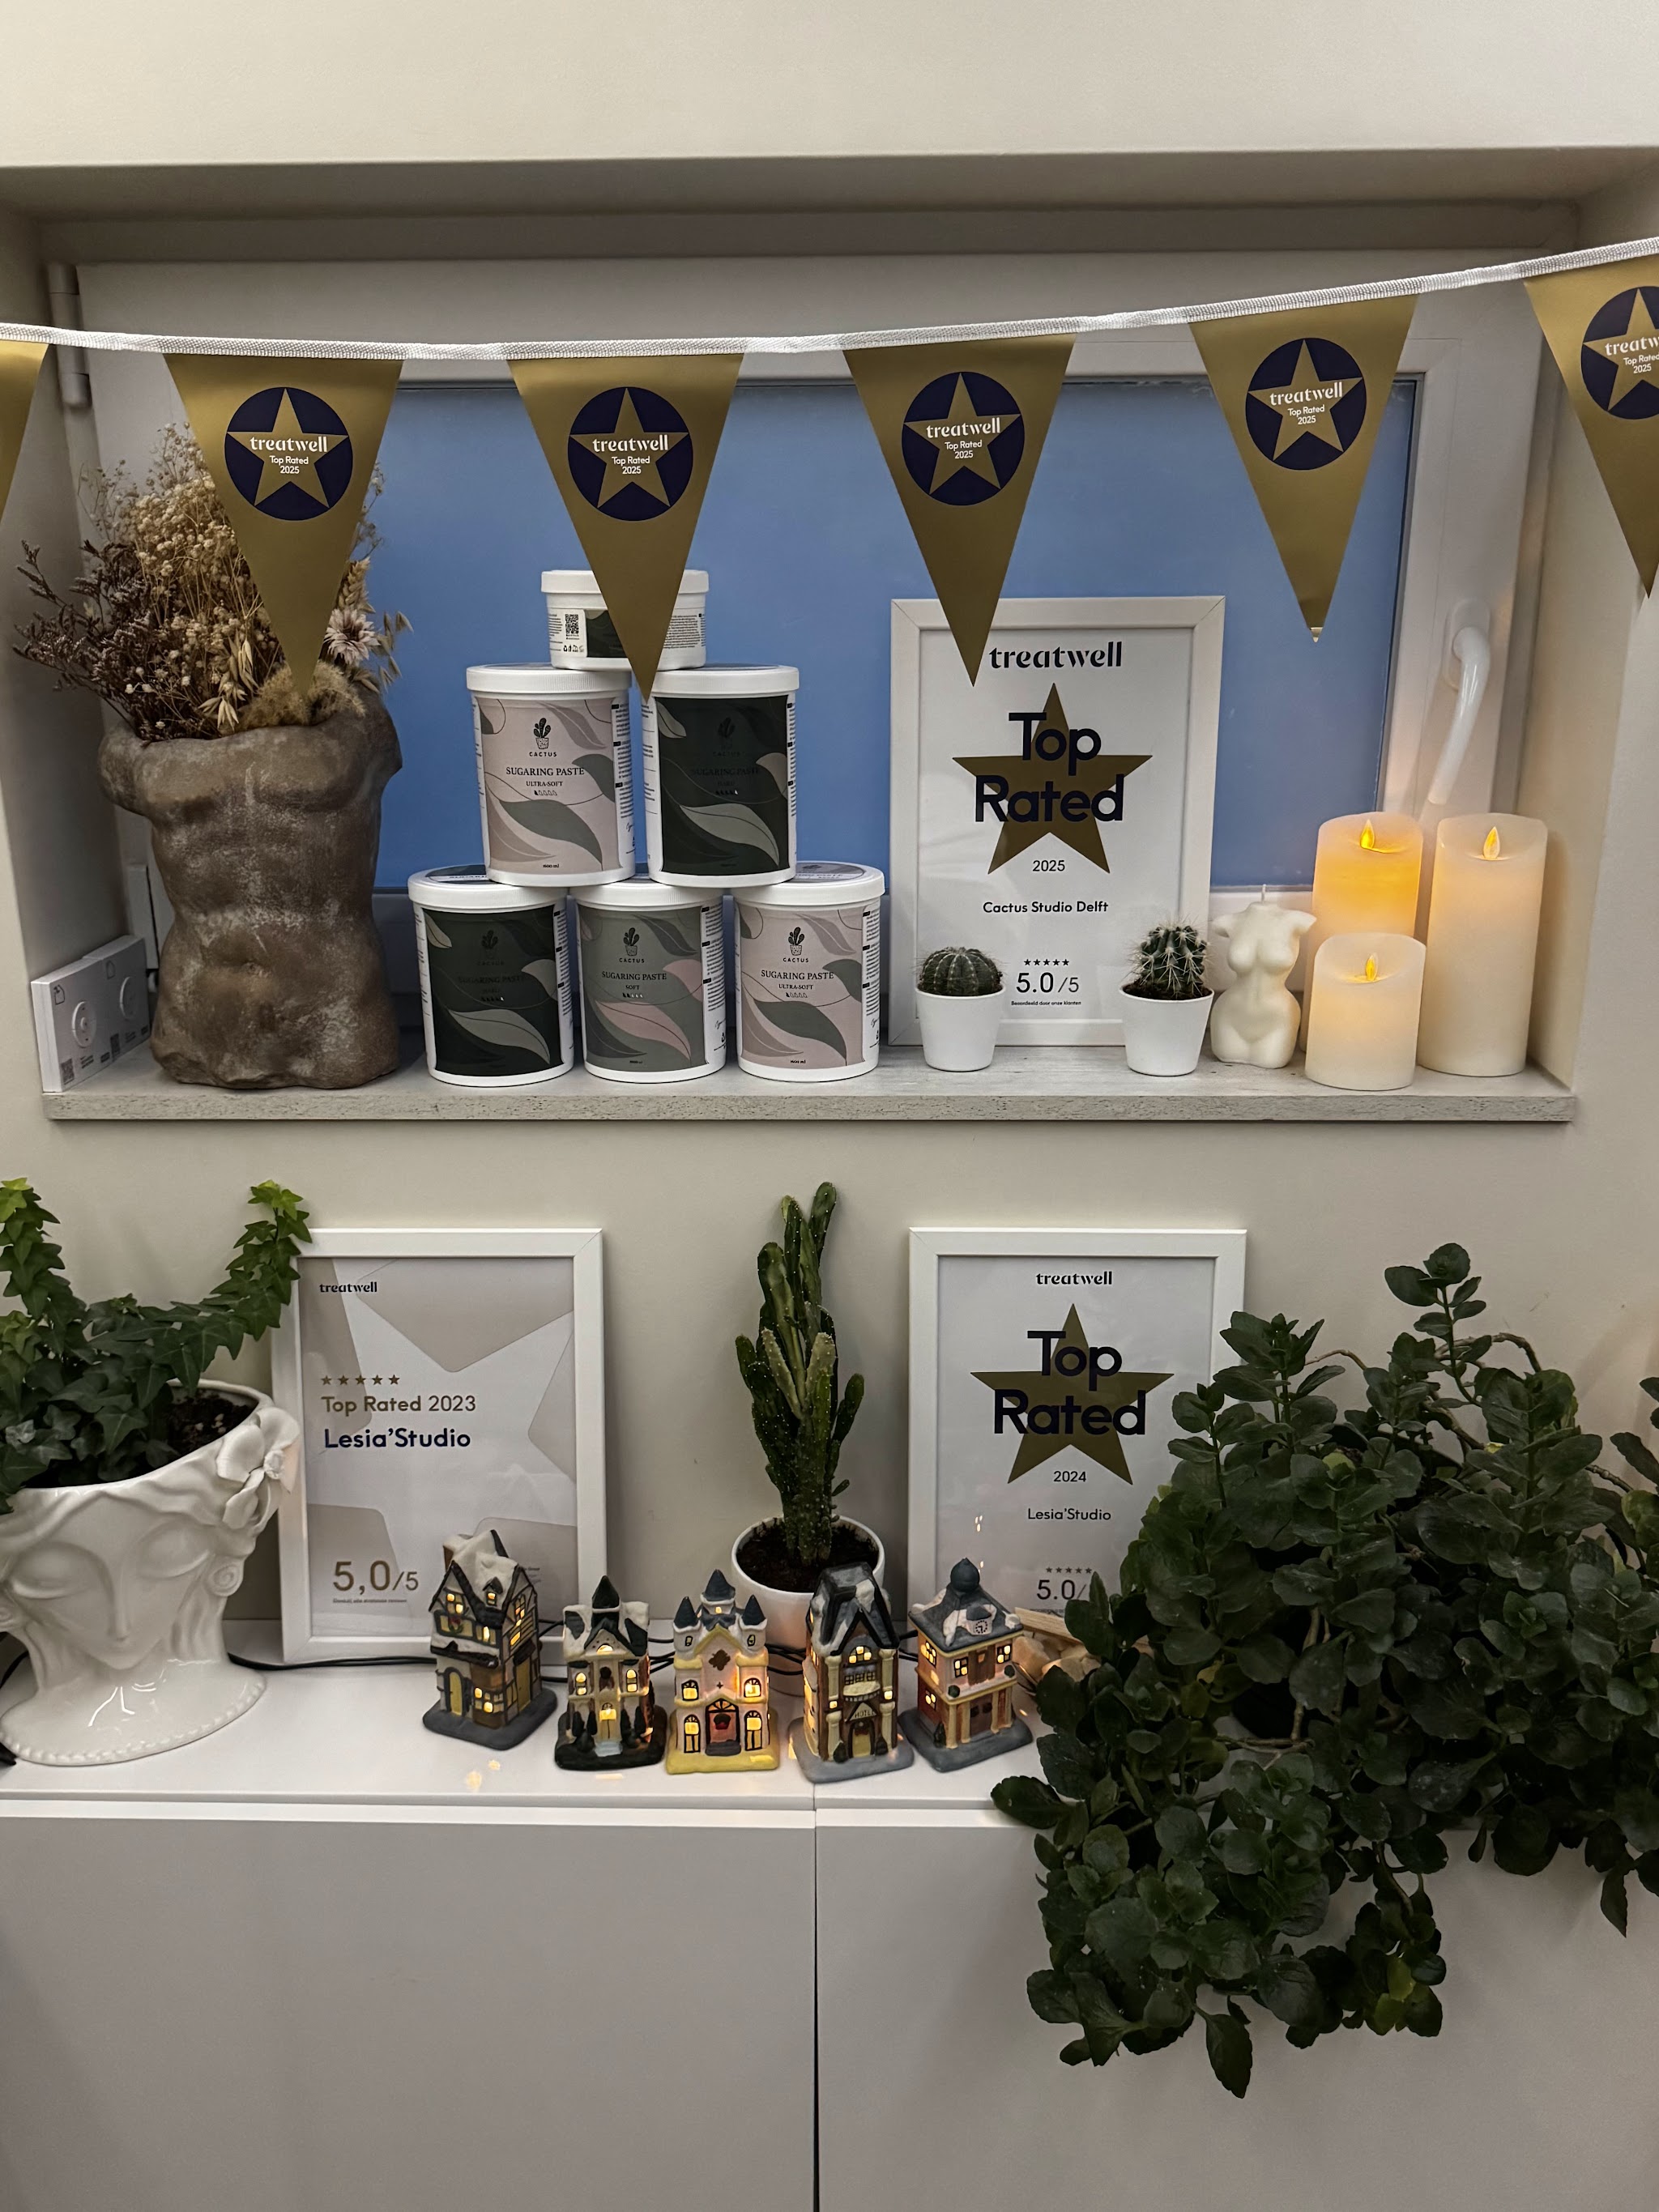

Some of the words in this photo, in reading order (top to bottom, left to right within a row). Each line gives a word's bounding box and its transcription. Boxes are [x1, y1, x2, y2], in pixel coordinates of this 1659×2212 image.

[1605, 336, 1659, 356] treatw
[1623, 357, 1637, 366] Top
[1633, 364, 1652, 373] 2025
[1269, 381, 1343, 406] treatwell
[1287, 408, 1302, 417] Top
[1303, 404, 1325, 414] Rated
[1298, 416, 1316, 424] 2025
[926, 417, 1001, 438] treatwell
[249, 436, 328, 452] treatwell
[592, 434, 668, 452] treatwell
[945, 441, 958, 451] Top
[960, 440, 983, 449] Rated
[269, 455, 284, 466] Top
[285, 456, 309, 465] Rated
[954, 450, 974, 459] 2025
[612, 456, 626, 467] Top
[627, 456, 650, 464] Rated
[280, 466, 300, 474] 2025
[622, 466, 642, 474] 2025
[988, 641, 1122, 669] treatwell
[1009, 712, 1102, 776] Top
[505, 767, 553, 776] SUGARING
[556, 768, 585, 776] PASTE
[975, 774, 1125, 823] Rated
[1032, 859, 1066, 872] 2025
[983, 901, 1028, 913] Cactus
[1031, 901, 1073, 913] Studio
[1077, 901, 1109, 912] Delft
[602, 971, 641, 980] SUGARING
[761, 970, 805, 980] SUGARING
[807, 972, 834, 980] PASTE
[1036, 1271, 1112, 1285] treatwell
[319, 1281, 377, 1293] treatwell
[1027, 1330, 1122, 1392] Top
[321, 1396, 356, 1417] Top
[364, 1395, 421, 1412] Rated
[429, 1395, 476, 1412] 2023
[993, 1389, 1146, 1436] Rated
[1053, 1470, 1086, 1482] 2024
[1037, 1579, 1086, 1600] 5.0/
